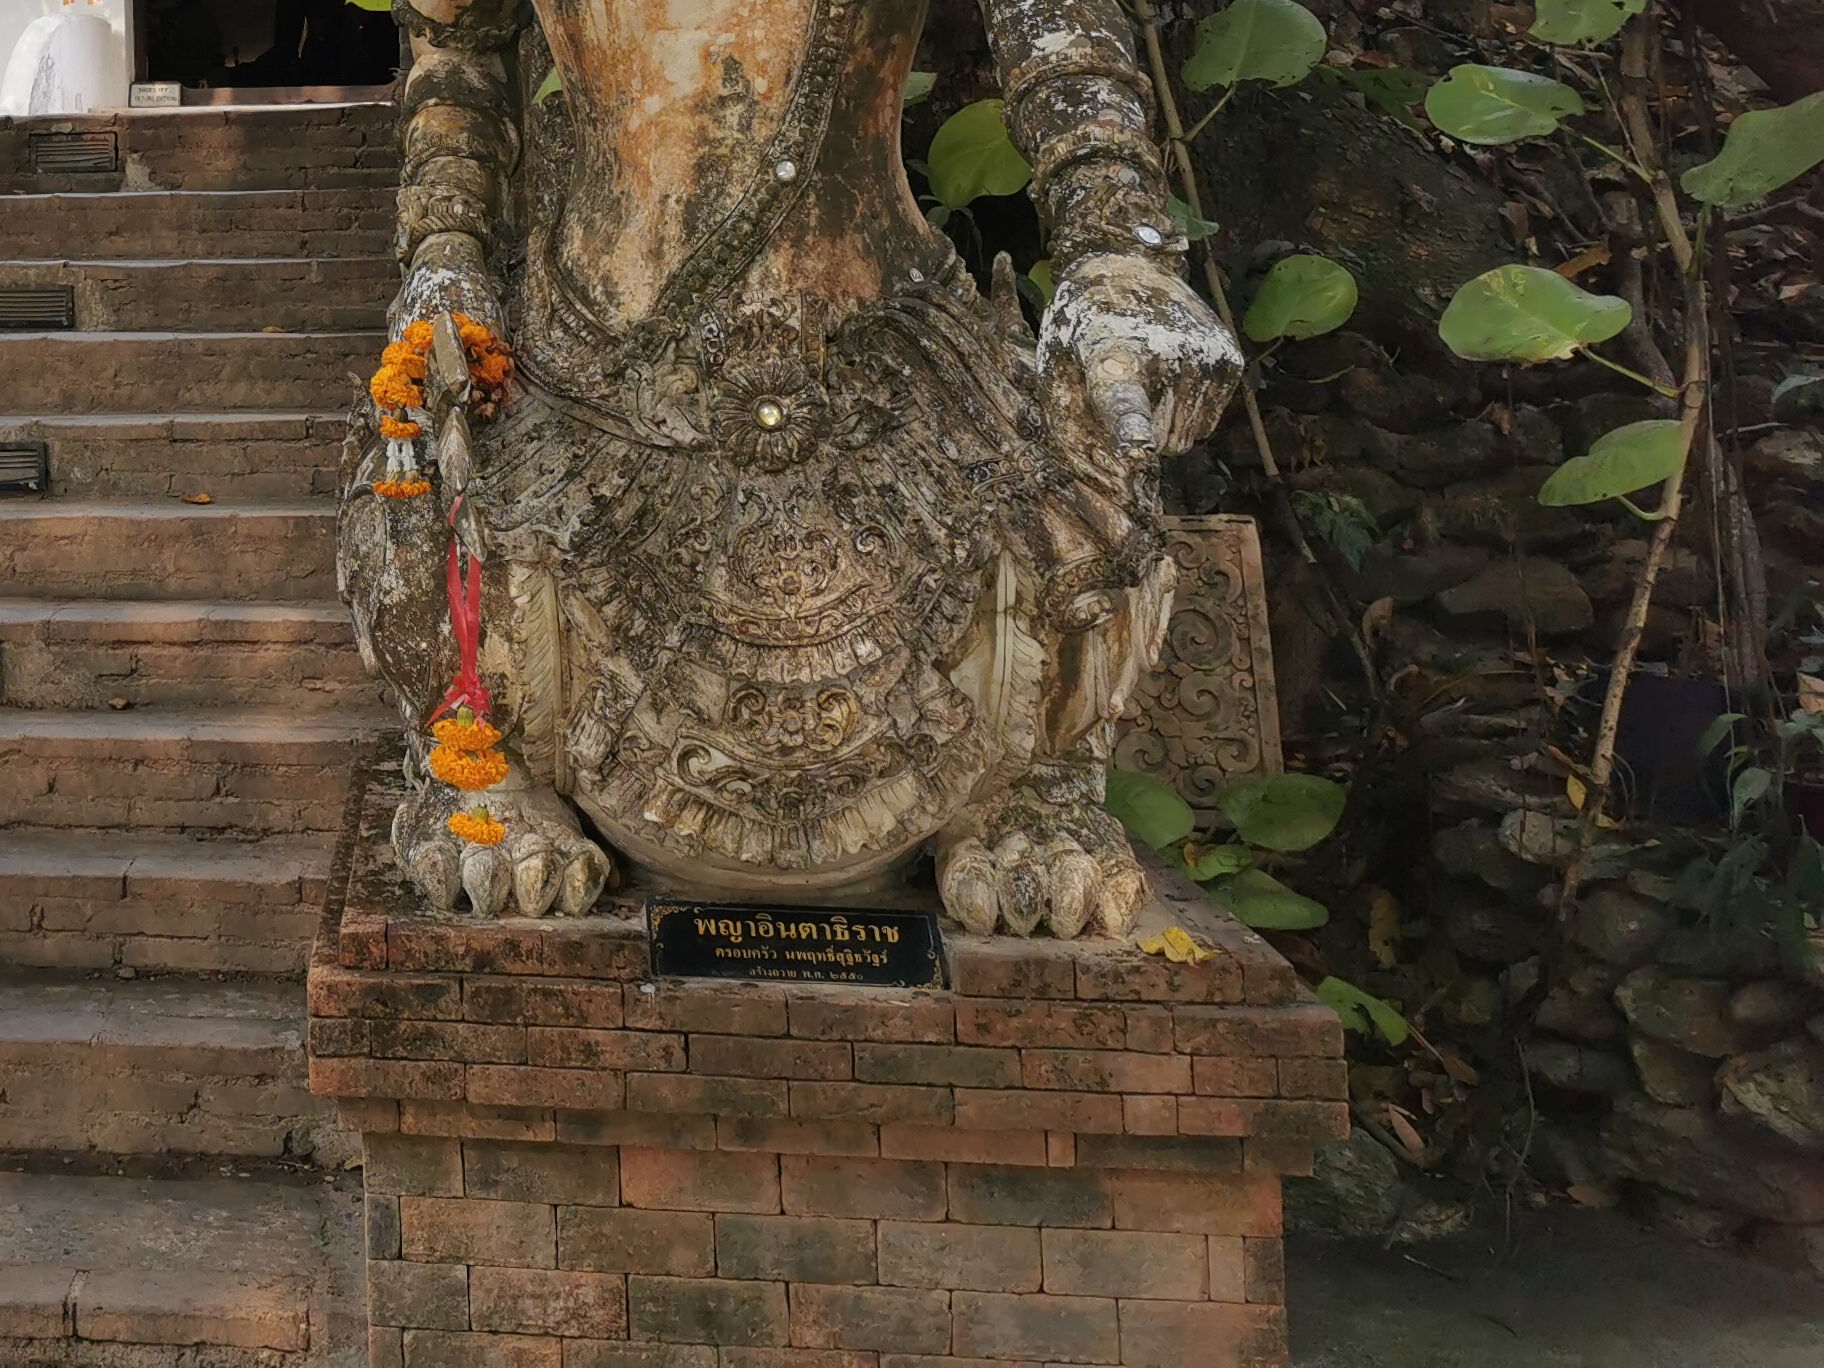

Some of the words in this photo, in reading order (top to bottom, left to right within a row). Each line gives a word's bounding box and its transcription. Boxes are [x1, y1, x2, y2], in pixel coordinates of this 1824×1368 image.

[693, 912, 901, 944] พญาอินตาธิราช
[715, 945, 778, 960] ครอบครัว
[749, 965, 797, 978] สร้างถวาย
[801, 970, 825, 980] พ.ศ.
